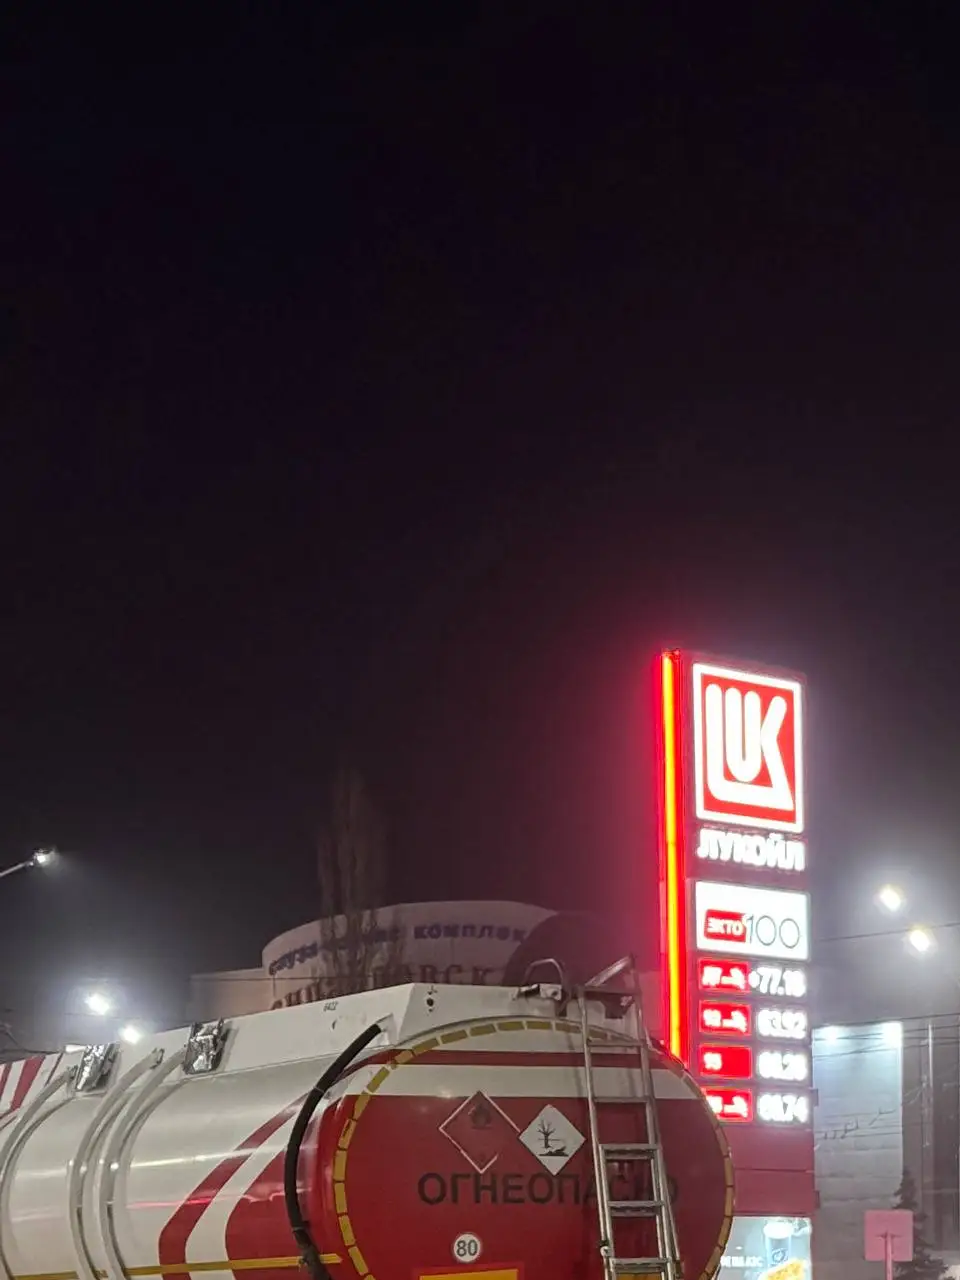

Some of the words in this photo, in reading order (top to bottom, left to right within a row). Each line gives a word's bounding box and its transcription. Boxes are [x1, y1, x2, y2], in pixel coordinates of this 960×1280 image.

[697, 828, 805, 871] ЛУКОЙЛ
[706, 916, 744, 936] ЭКТО
[746, 914, 800, 949] 100
[456, 1239, 478, 1257] 80
